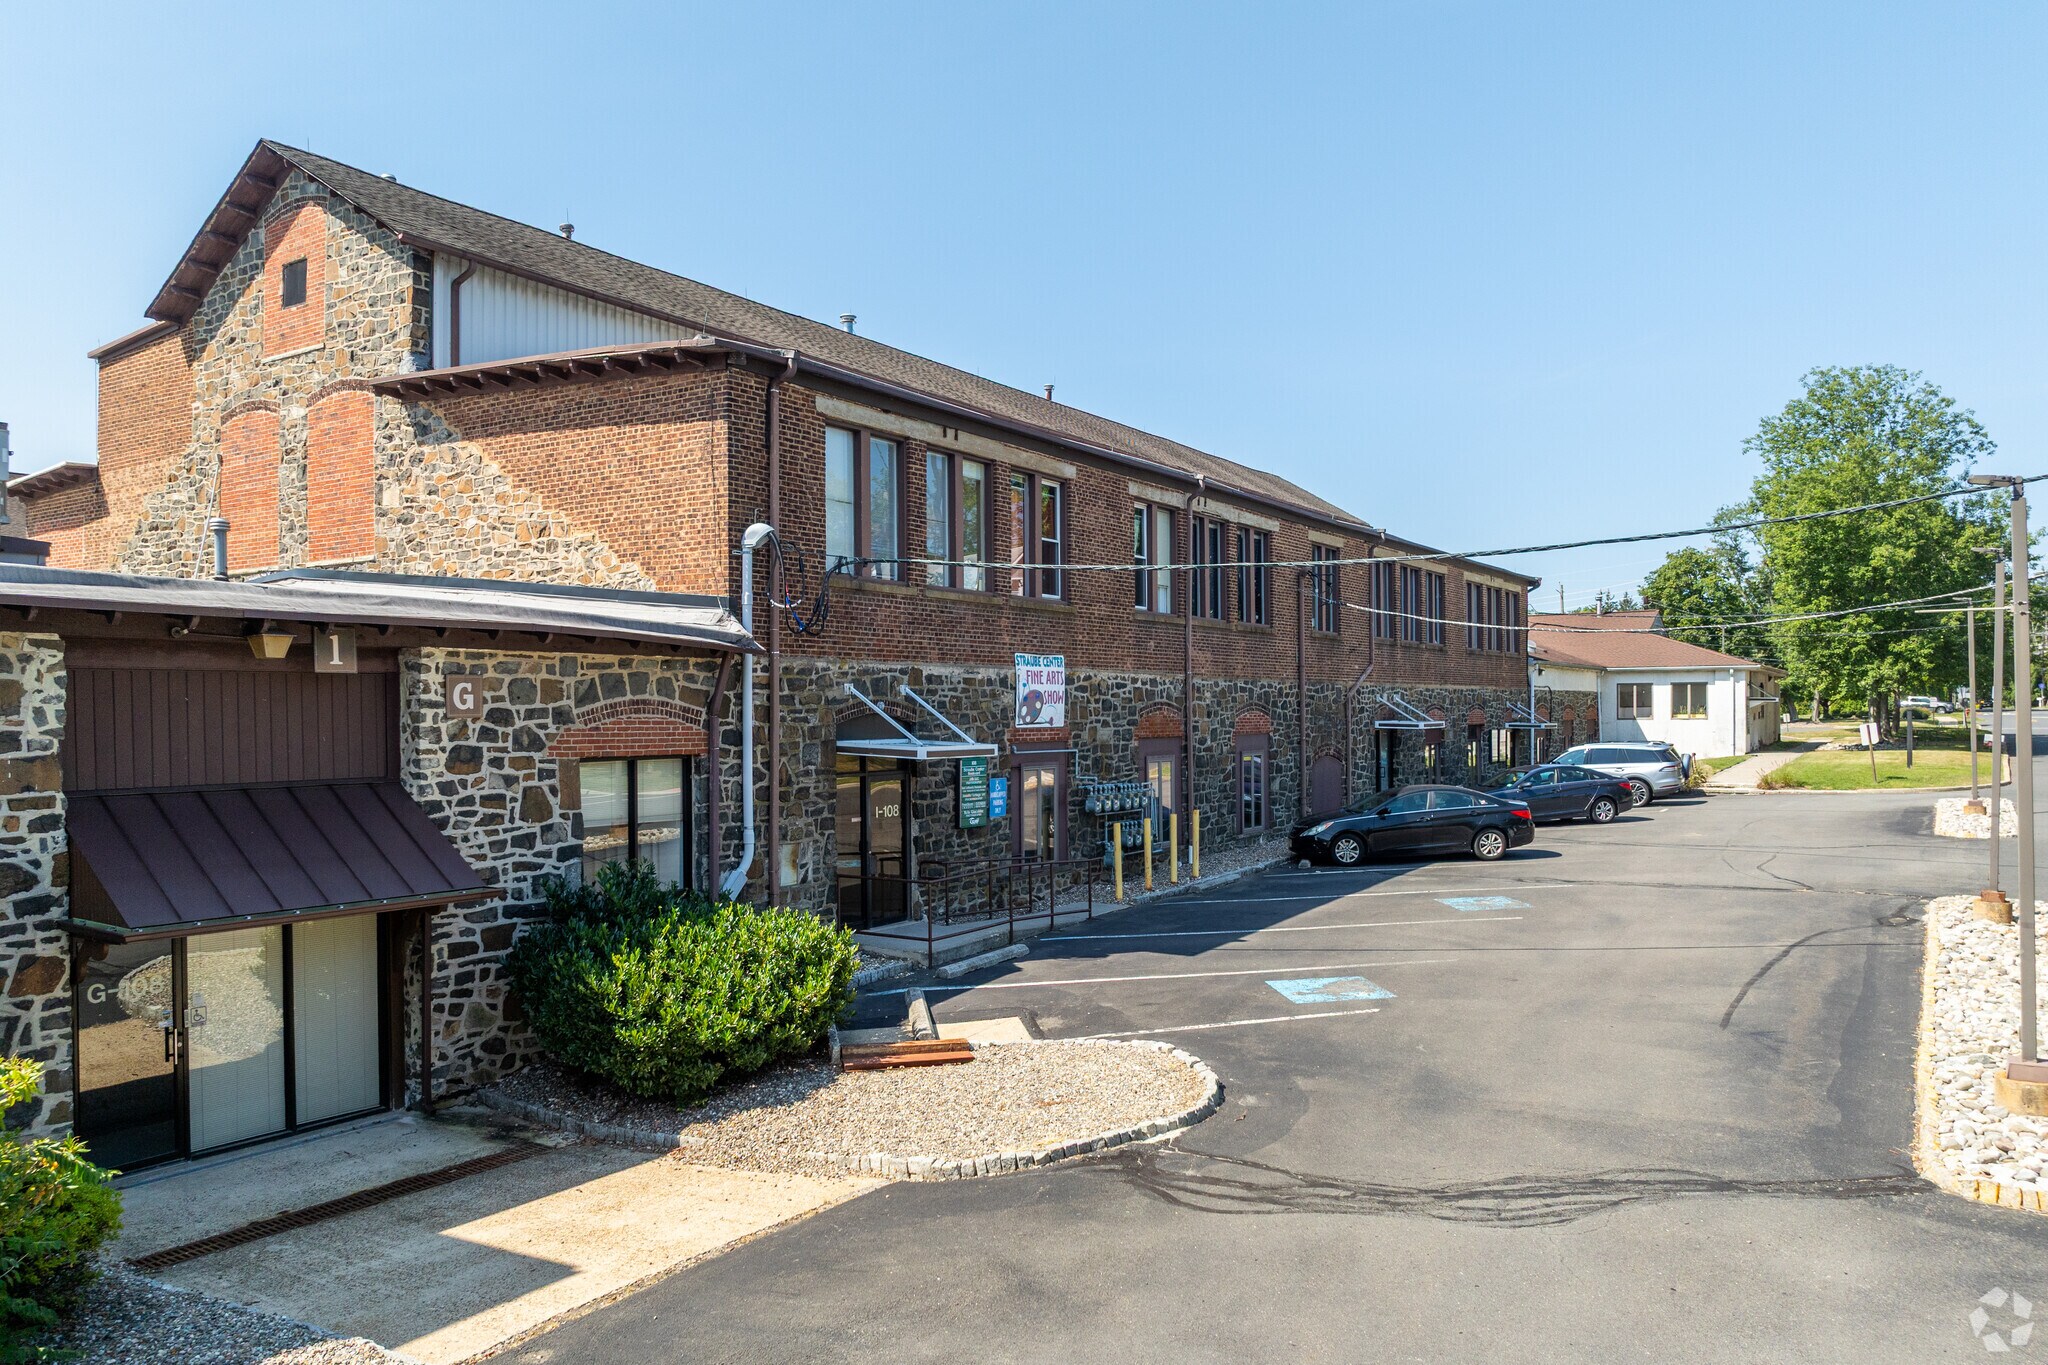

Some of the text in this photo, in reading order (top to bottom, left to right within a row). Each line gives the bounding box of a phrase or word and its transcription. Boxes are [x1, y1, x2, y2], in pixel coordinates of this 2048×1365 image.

[329, 634, 344, 665] 1
[1015, 654, 1064, 668] STRAUBE CENTER
[1026, 670, 1064, 685] FINE ARTS
[452, 682, 474, 710] G
[1043, 690, 1064, 705] SHOW
[86, 975, 165, 1004] G-108
